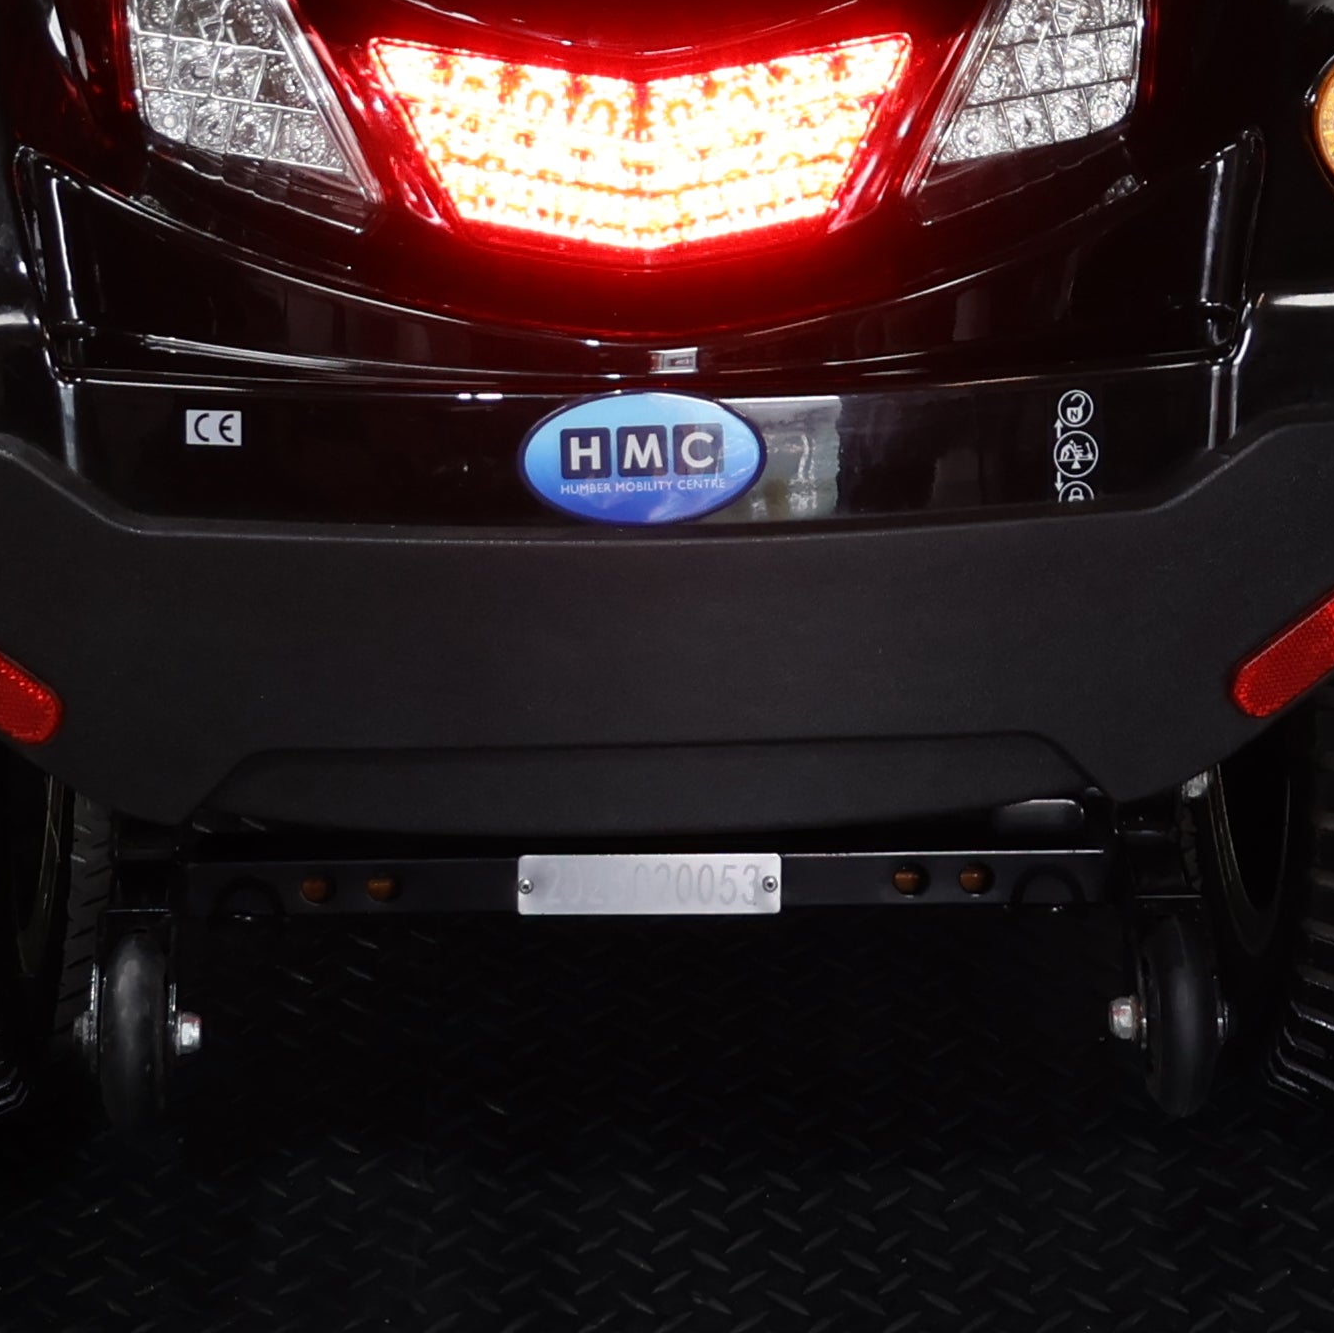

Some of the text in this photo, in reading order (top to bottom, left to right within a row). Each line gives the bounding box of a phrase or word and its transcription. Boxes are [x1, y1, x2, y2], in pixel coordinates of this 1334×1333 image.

[194, 413, 234, 443] CE
[570, 432, 714, 470] HMC
[561, 479, 726, 494] HUMBER MOBILITY CENTRE
